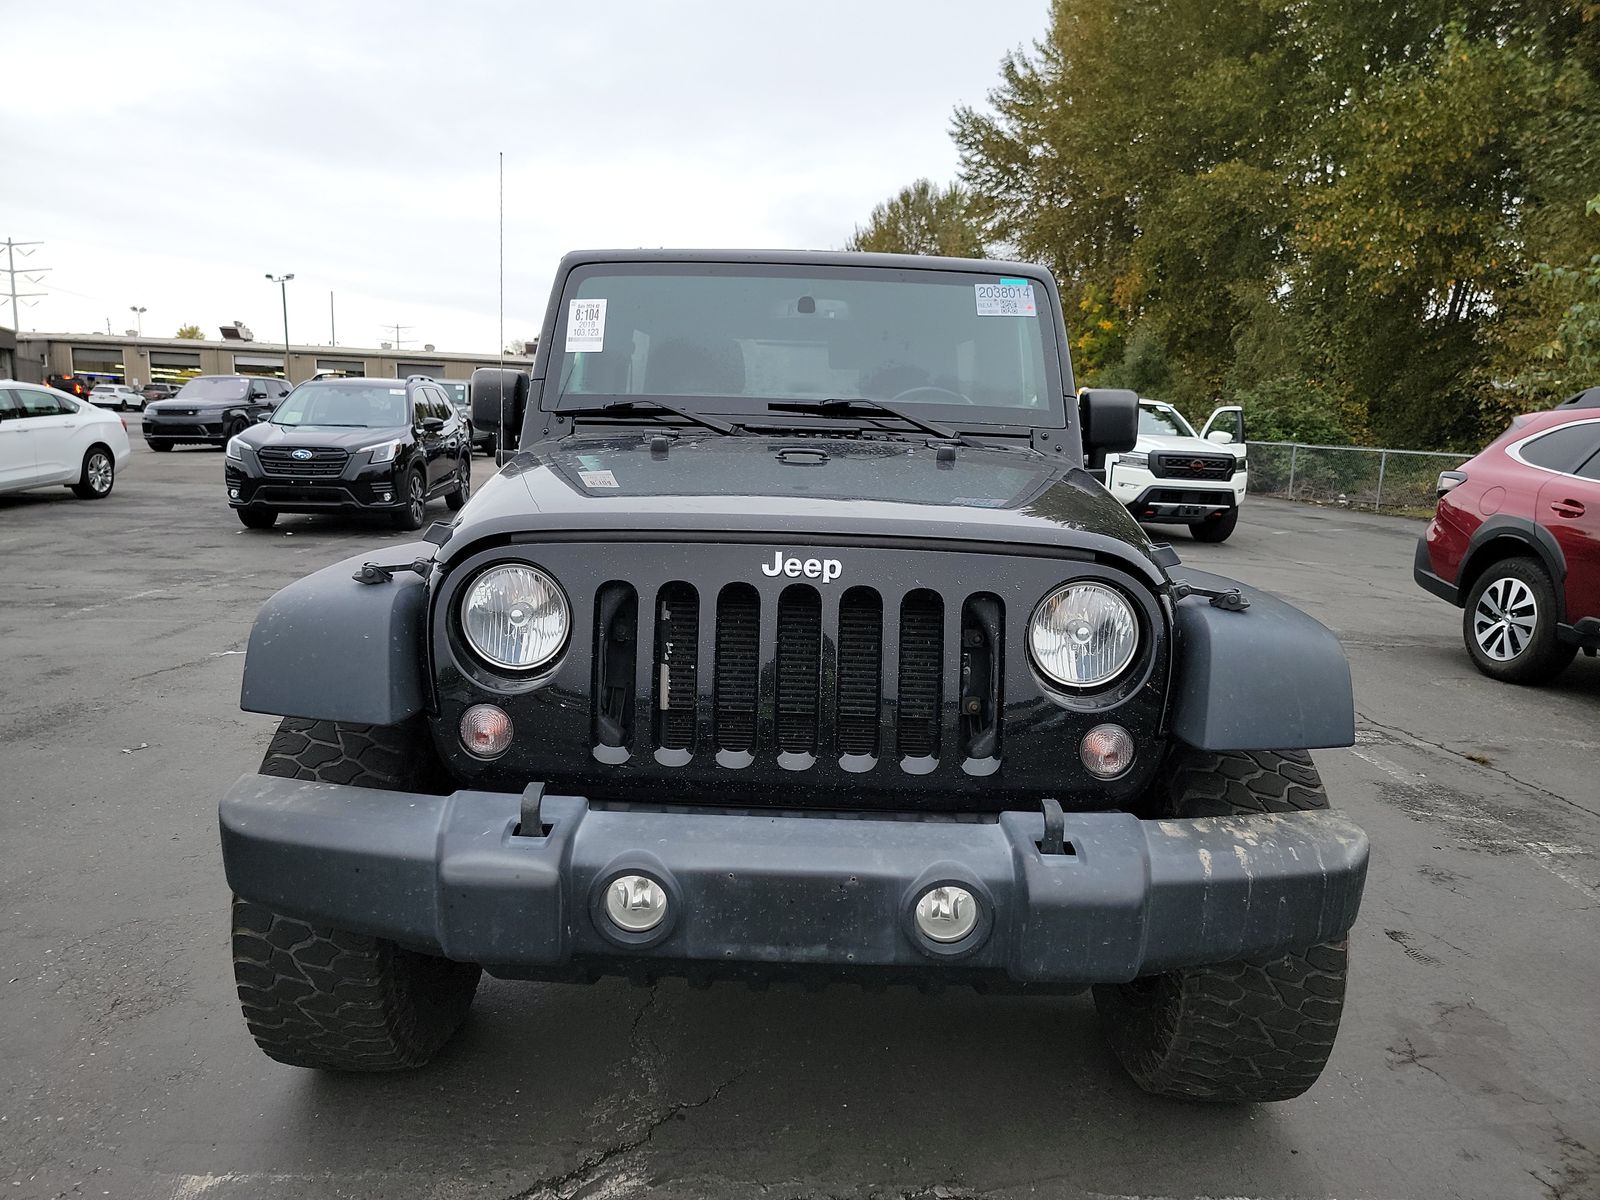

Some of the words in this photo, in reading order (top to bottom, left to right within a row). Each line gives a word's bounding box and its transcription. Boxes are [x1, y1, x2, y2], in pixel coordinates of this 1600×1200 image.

[979, 286, 1031, 298] 2038014
[575, 308, 600, 321] 8:104
[761, 551, 842, 584] Jeep
